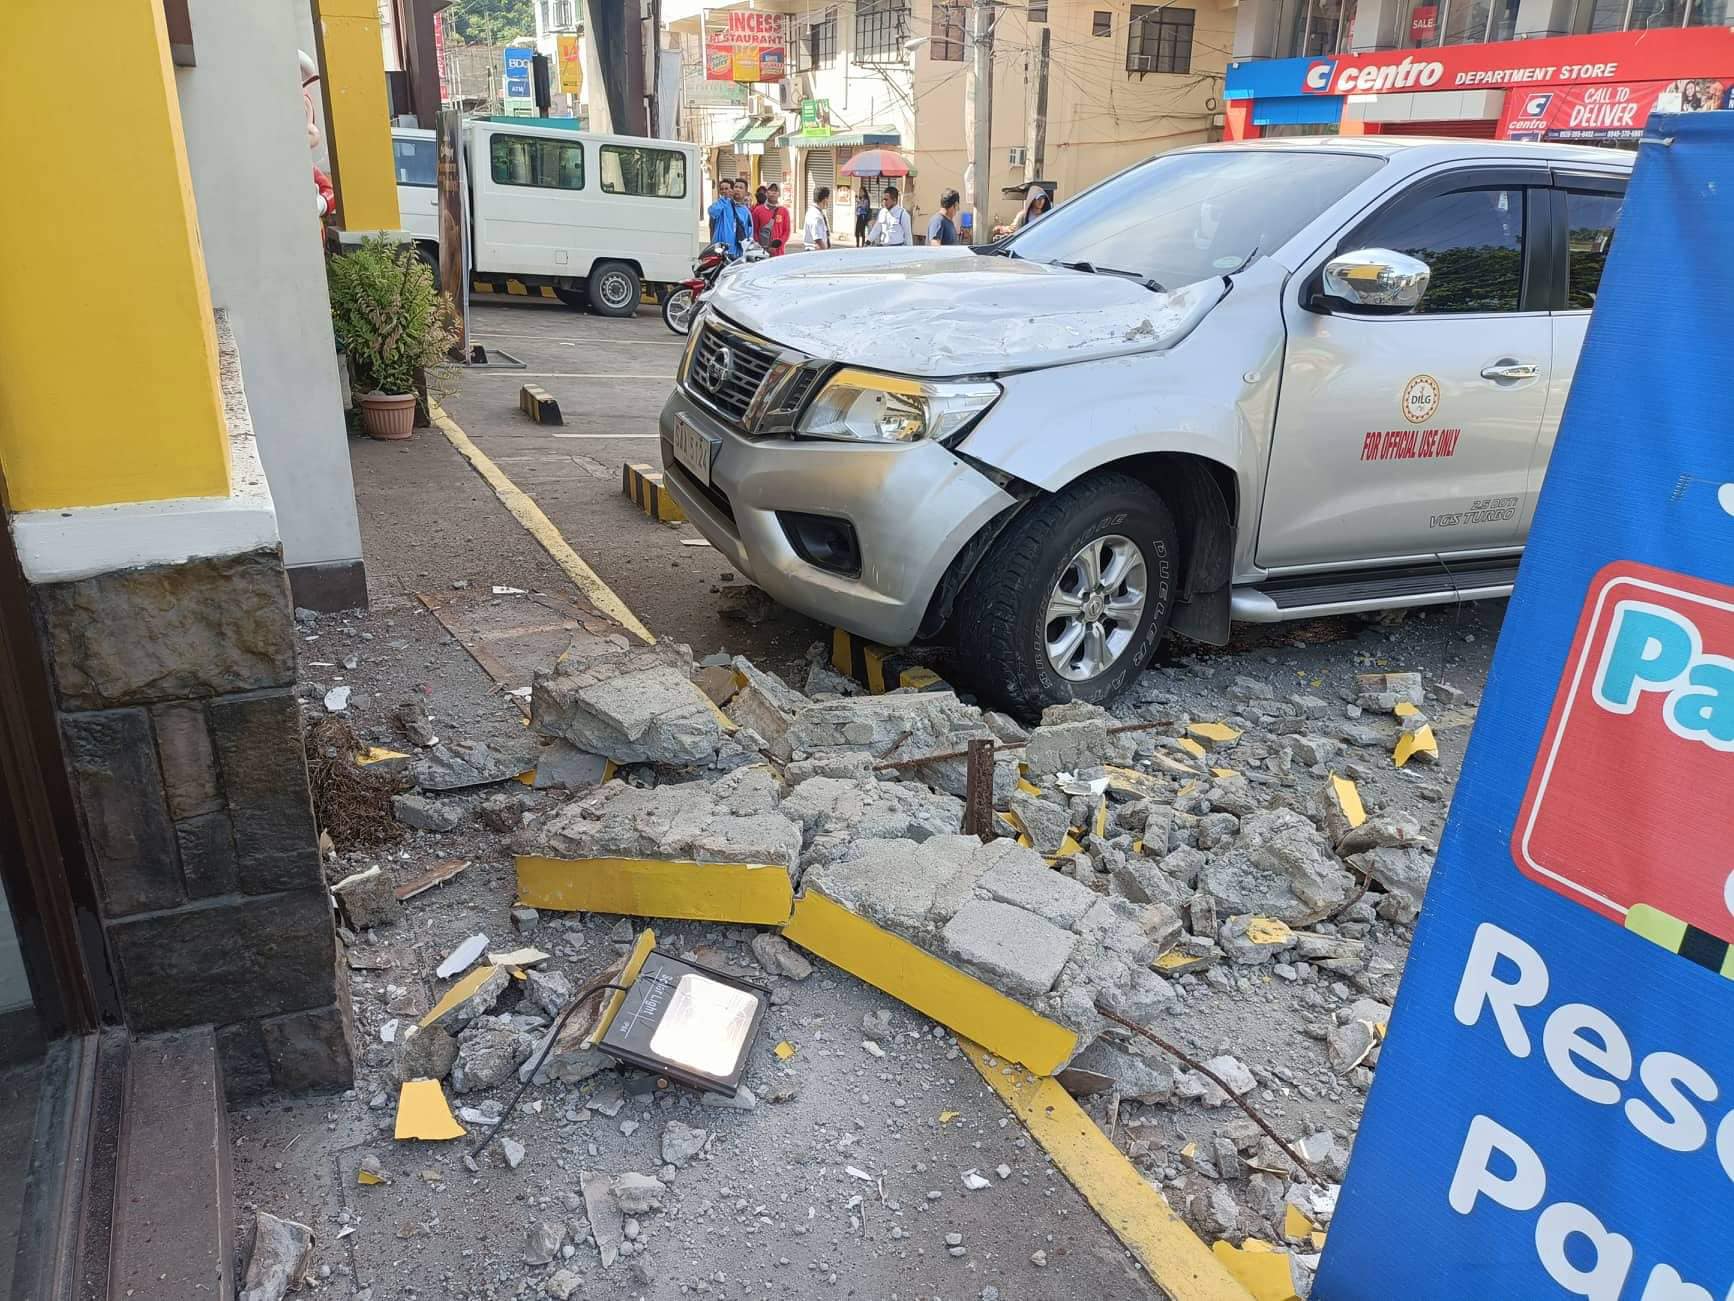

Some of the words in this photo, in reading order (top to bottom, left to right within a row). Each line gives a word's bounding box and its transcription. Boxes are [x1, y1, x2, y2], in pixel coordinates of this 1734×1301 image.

[1412, 18, 1434, 29] SALE
[1337, 56, 1445, 91] centro
[1455, 67, 1556, 85] DEPARTMENT
[1560, 63, 1618, 80] STORE
[1584, 88, 1611, 103] CALL
[1616, 87, 1630, 101] TO
[1509, 119, 1547, 129] centro
[1570, 104, 1638, 127] DELIVER
[1411, 395, 1431, 405] DILG
[1360, 431, 1382, 460] FOR
[1380, 430, 1419, 459] OFFICIAL
[1418, 429, 1439, 458] USE
[1436, 428, 1461, 457] ONLY
[1463, 508, 1516, 524] TURBO
[1454, 922, 1734, 1183] Res
[1449, 1114, 1734, 1301] Pa
